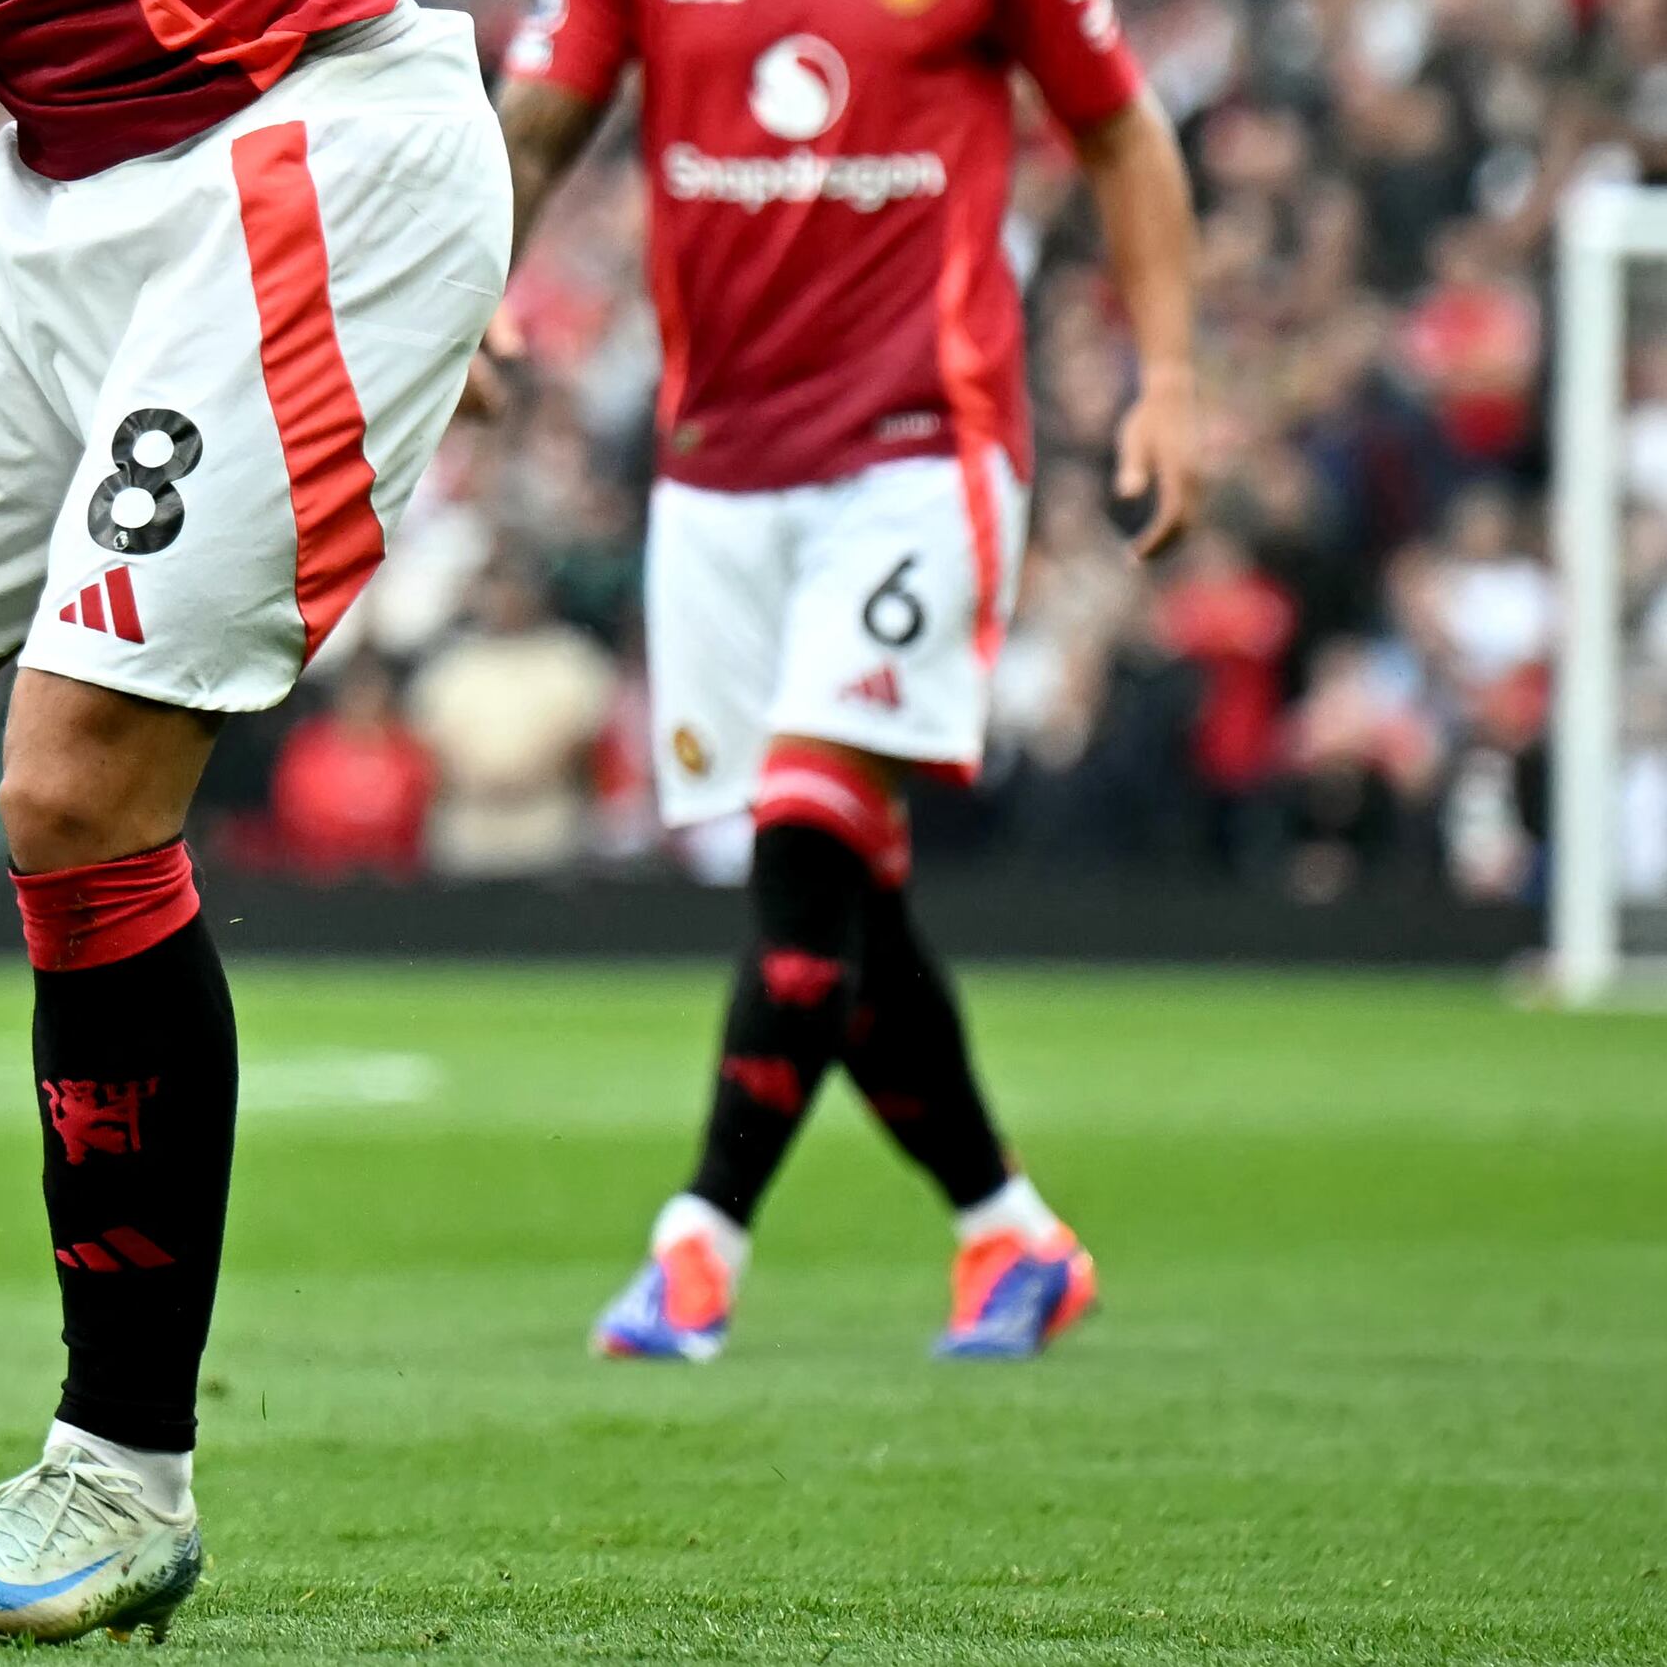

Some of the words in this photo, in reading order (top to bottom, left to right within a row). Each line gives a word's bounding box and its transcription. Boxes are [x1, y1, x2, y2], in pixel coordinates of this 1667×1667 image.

[663, 142, 947, 213] Snapdragon
[87, 408, 204, 555] 8
[862, 552, 926, 649] 6
